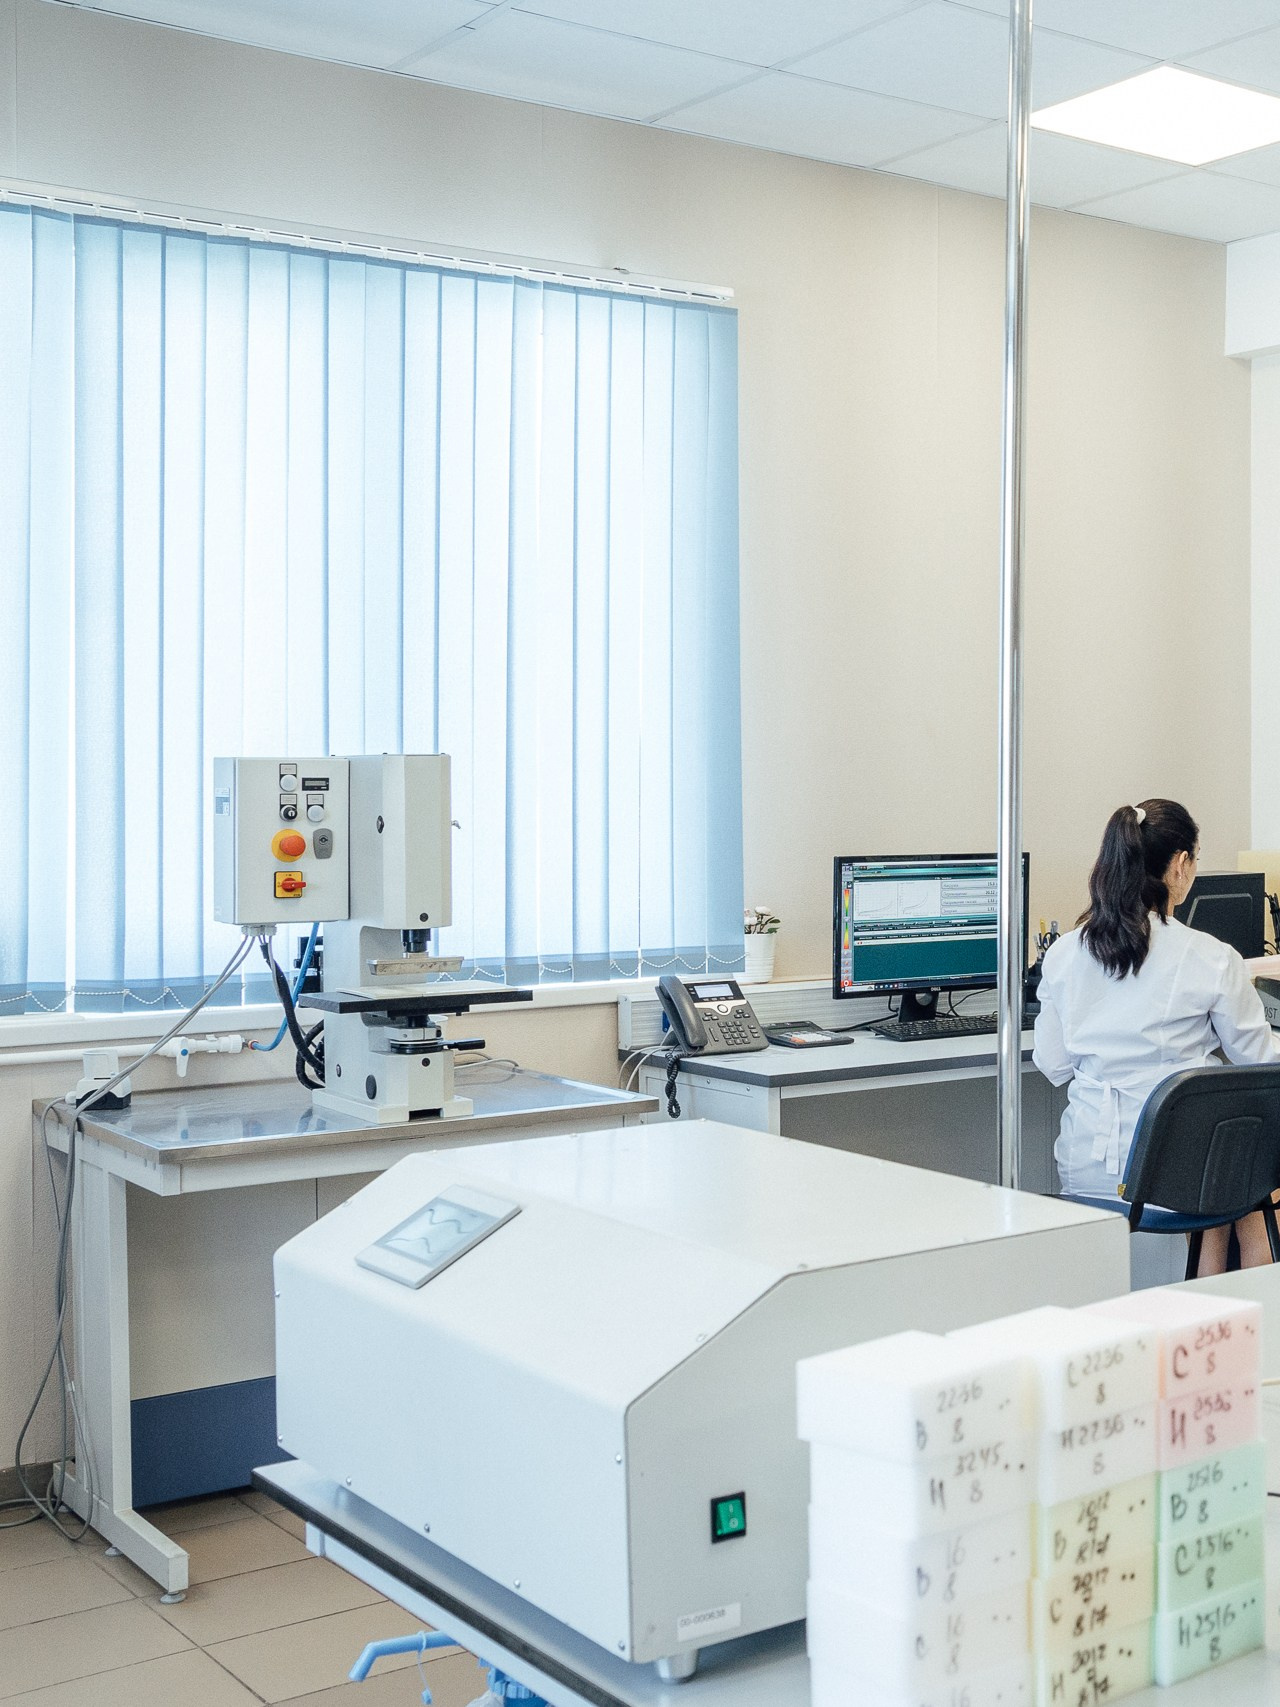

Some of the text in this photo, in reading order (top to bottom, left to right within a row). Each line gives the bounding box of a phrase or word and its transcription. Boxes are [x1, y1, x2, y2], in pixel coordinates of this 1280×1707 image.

[1194, 1318, 1232, 1351] 2536
[1066, 1342, 1126, 1389] C 2236
[1172, 1344, 1190, 1380] C
[937, 1377, 984, 1414] 2236
[1078, 1413, 1126, 1447] 2236
[954, 1440, 1005, 1478] 3245
[968, 1478, 984, 1505] 8
[1170, 1493, 1210, 1525] B 8
[1174, 1529, 1235, 1577] C 2516
[942, 1570, 957, 1603] 8
[1205, 1565, 1217, 1590] 8
[1049, 1598, 1063, 1625] C
[1178, 1602, 1236, 1649] H 2516
[1051, 1669, 1066, 1702] H
